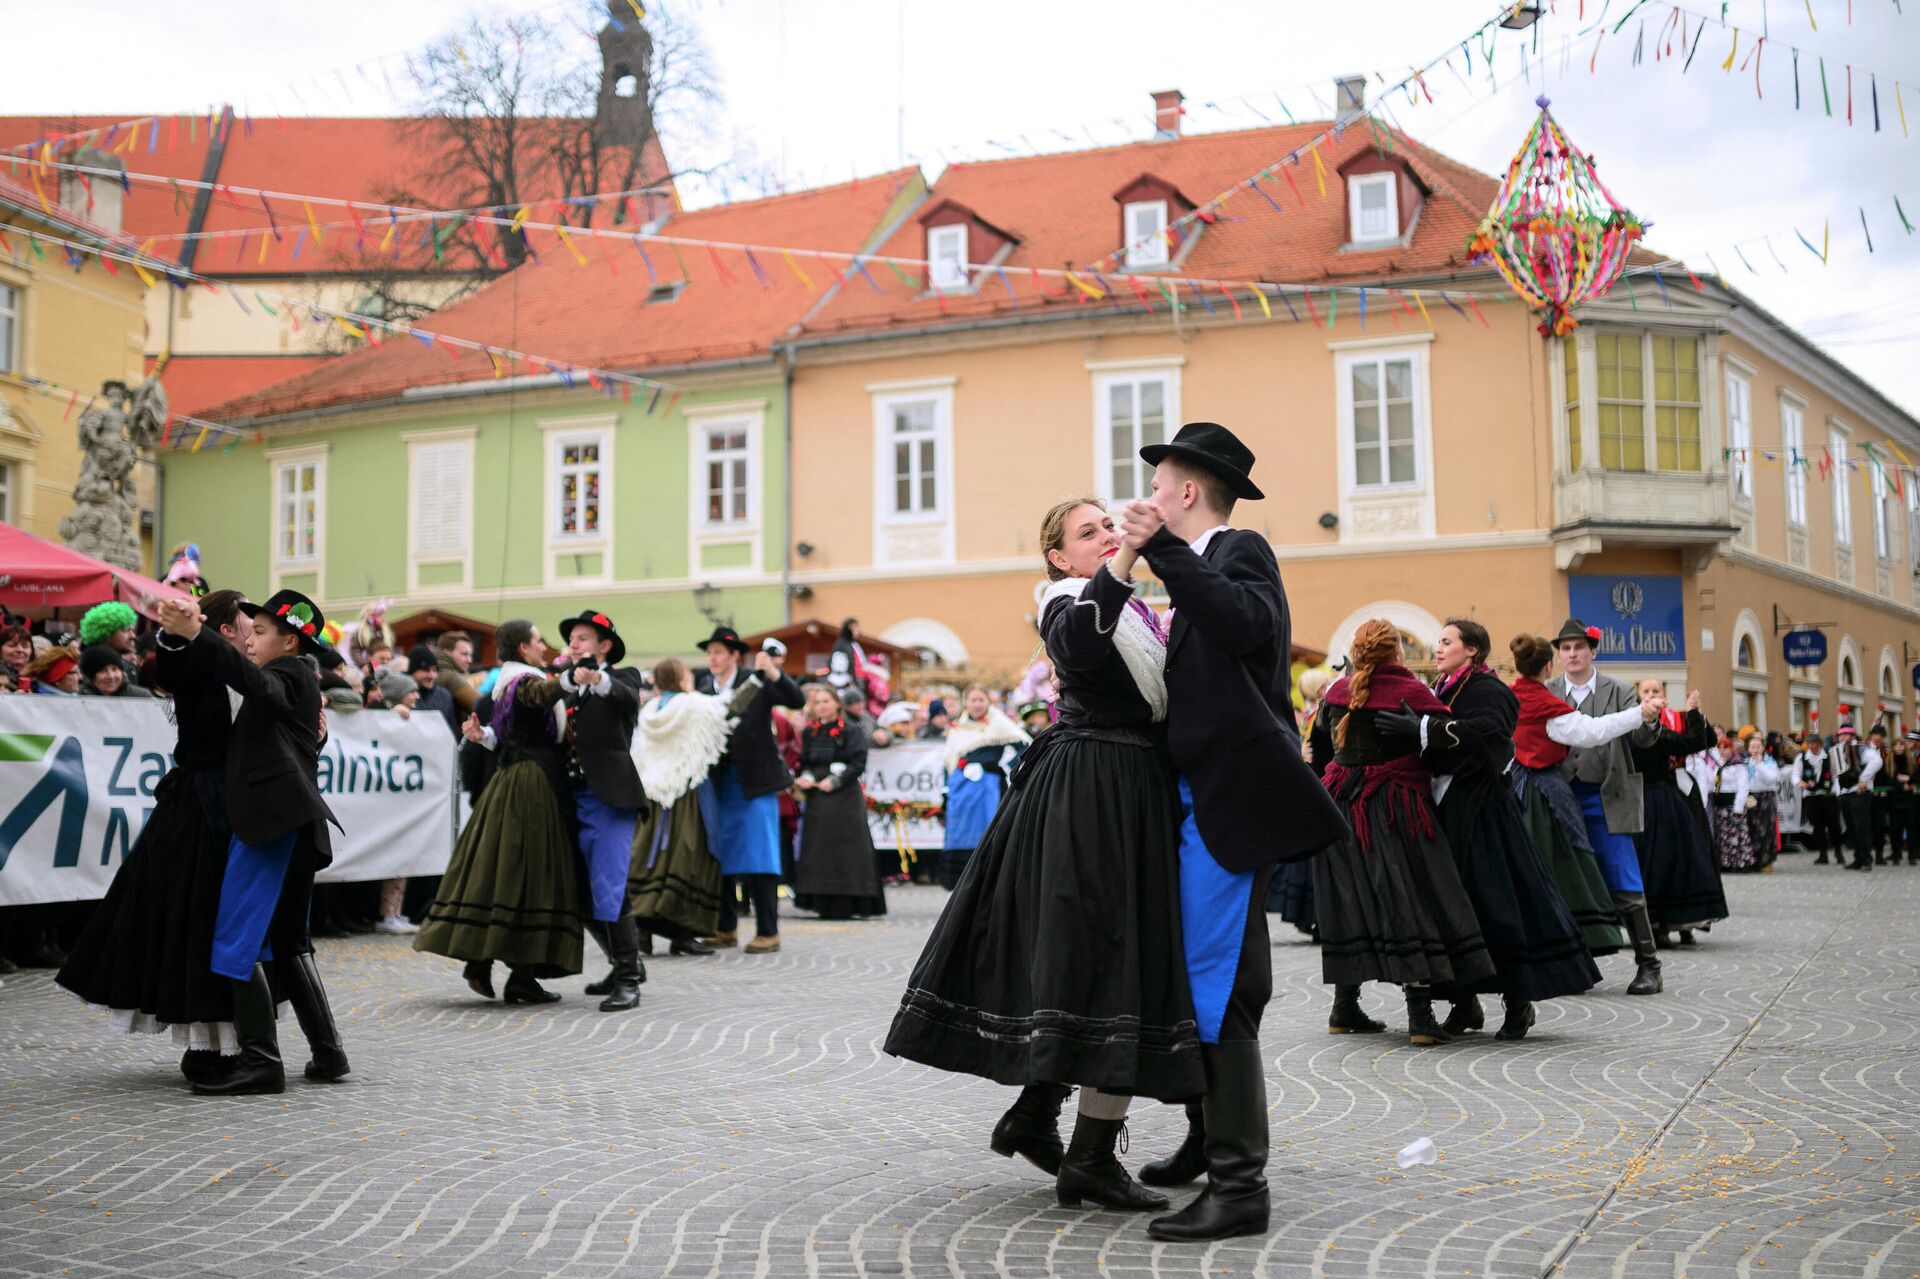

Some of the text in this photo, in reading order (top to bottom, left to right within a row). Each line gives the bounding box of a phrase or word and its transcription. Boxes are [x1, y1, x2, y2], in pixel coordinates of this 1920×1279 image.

[14, 584, 65, 592] LJUBLJANA
[1598, 624, 1676, 655] tika Clarus
[896, 770, 944, 793] OB
